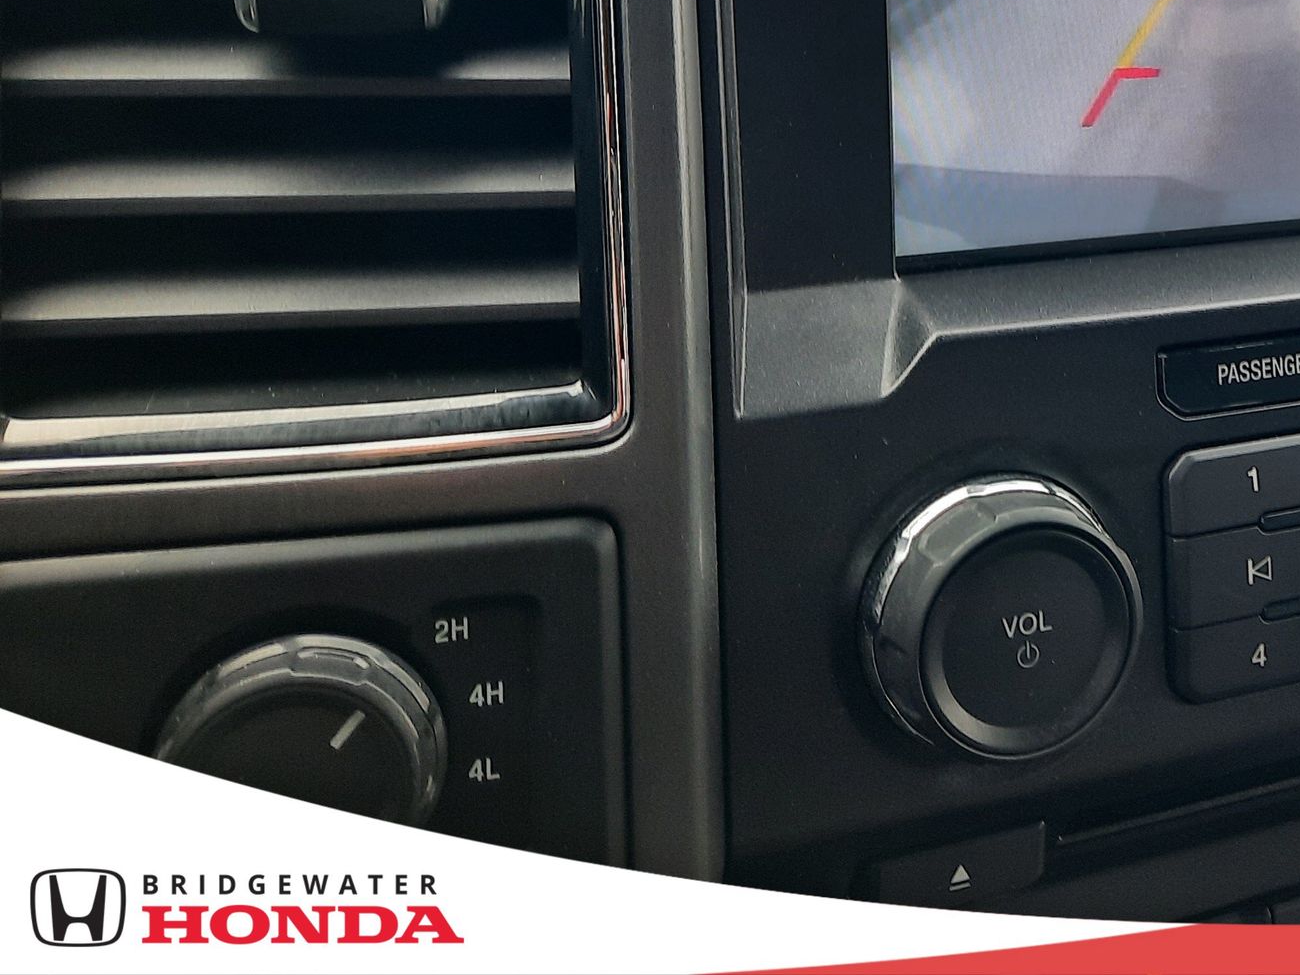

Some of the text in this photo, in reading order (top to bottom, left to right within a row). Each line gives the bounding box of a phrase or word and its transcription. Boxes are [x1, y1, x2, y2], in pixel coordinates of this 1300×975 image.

[1247, 466, 1260, 492] 1
[434, 617, 469, 644] 2H
[1002, 610, 1052, 638] VOL
[1252, 644, 1267, 667] 4
[469, 680, 504, 707] 4H
[468, 758, 500, 782] 4L
